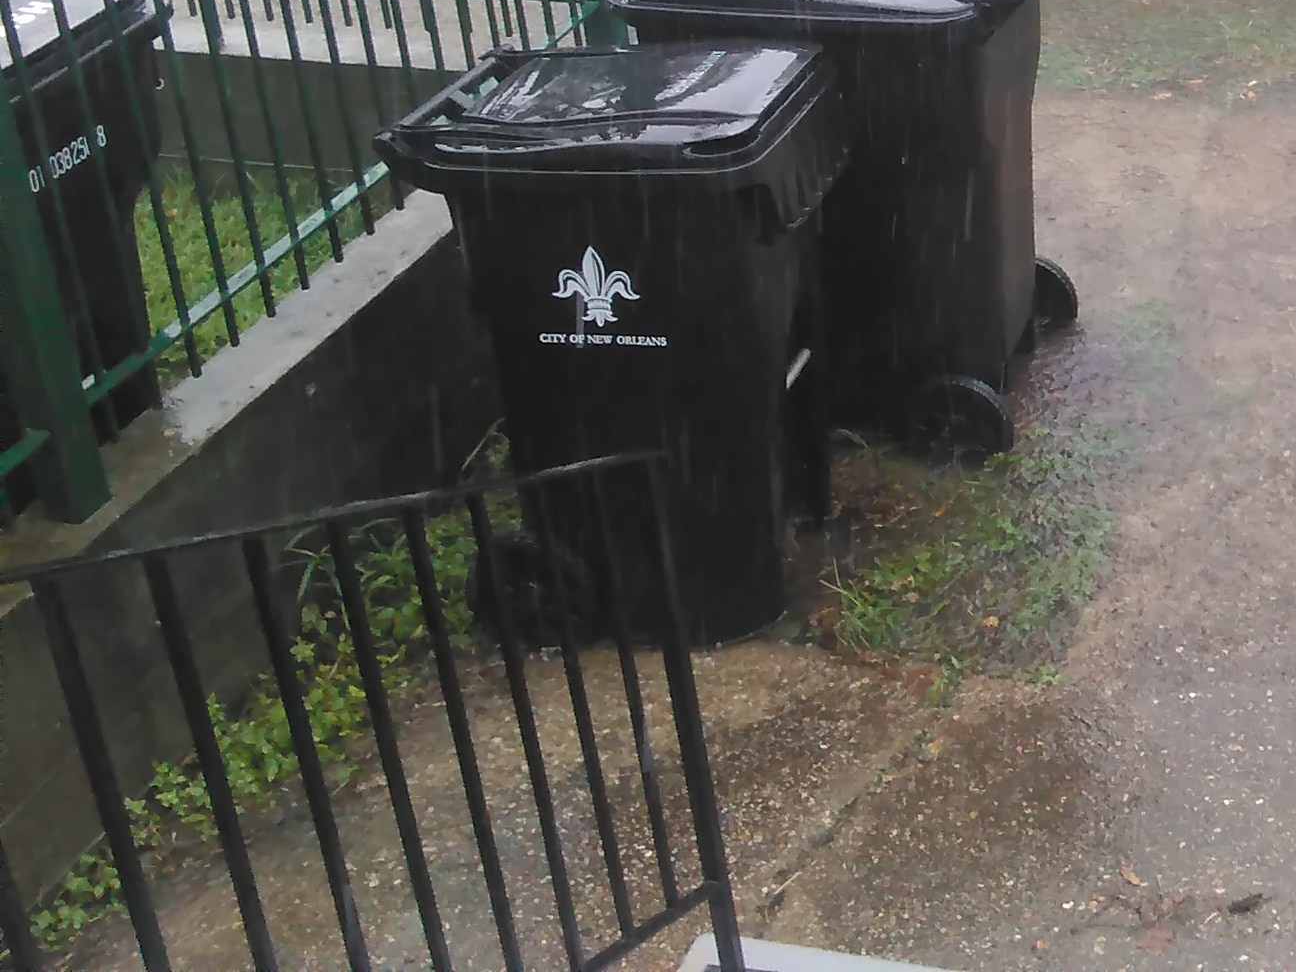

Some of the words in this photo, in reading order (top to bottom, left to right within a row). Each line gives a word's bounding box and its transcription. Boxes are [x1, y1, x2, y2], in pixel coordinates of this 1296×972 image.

[539, 333, 567, 344] CITY
[569, 334, 585, 344] OF
[586, 335, 613, 345] NEW
[616, 335, 667, 347] ORLEANS
